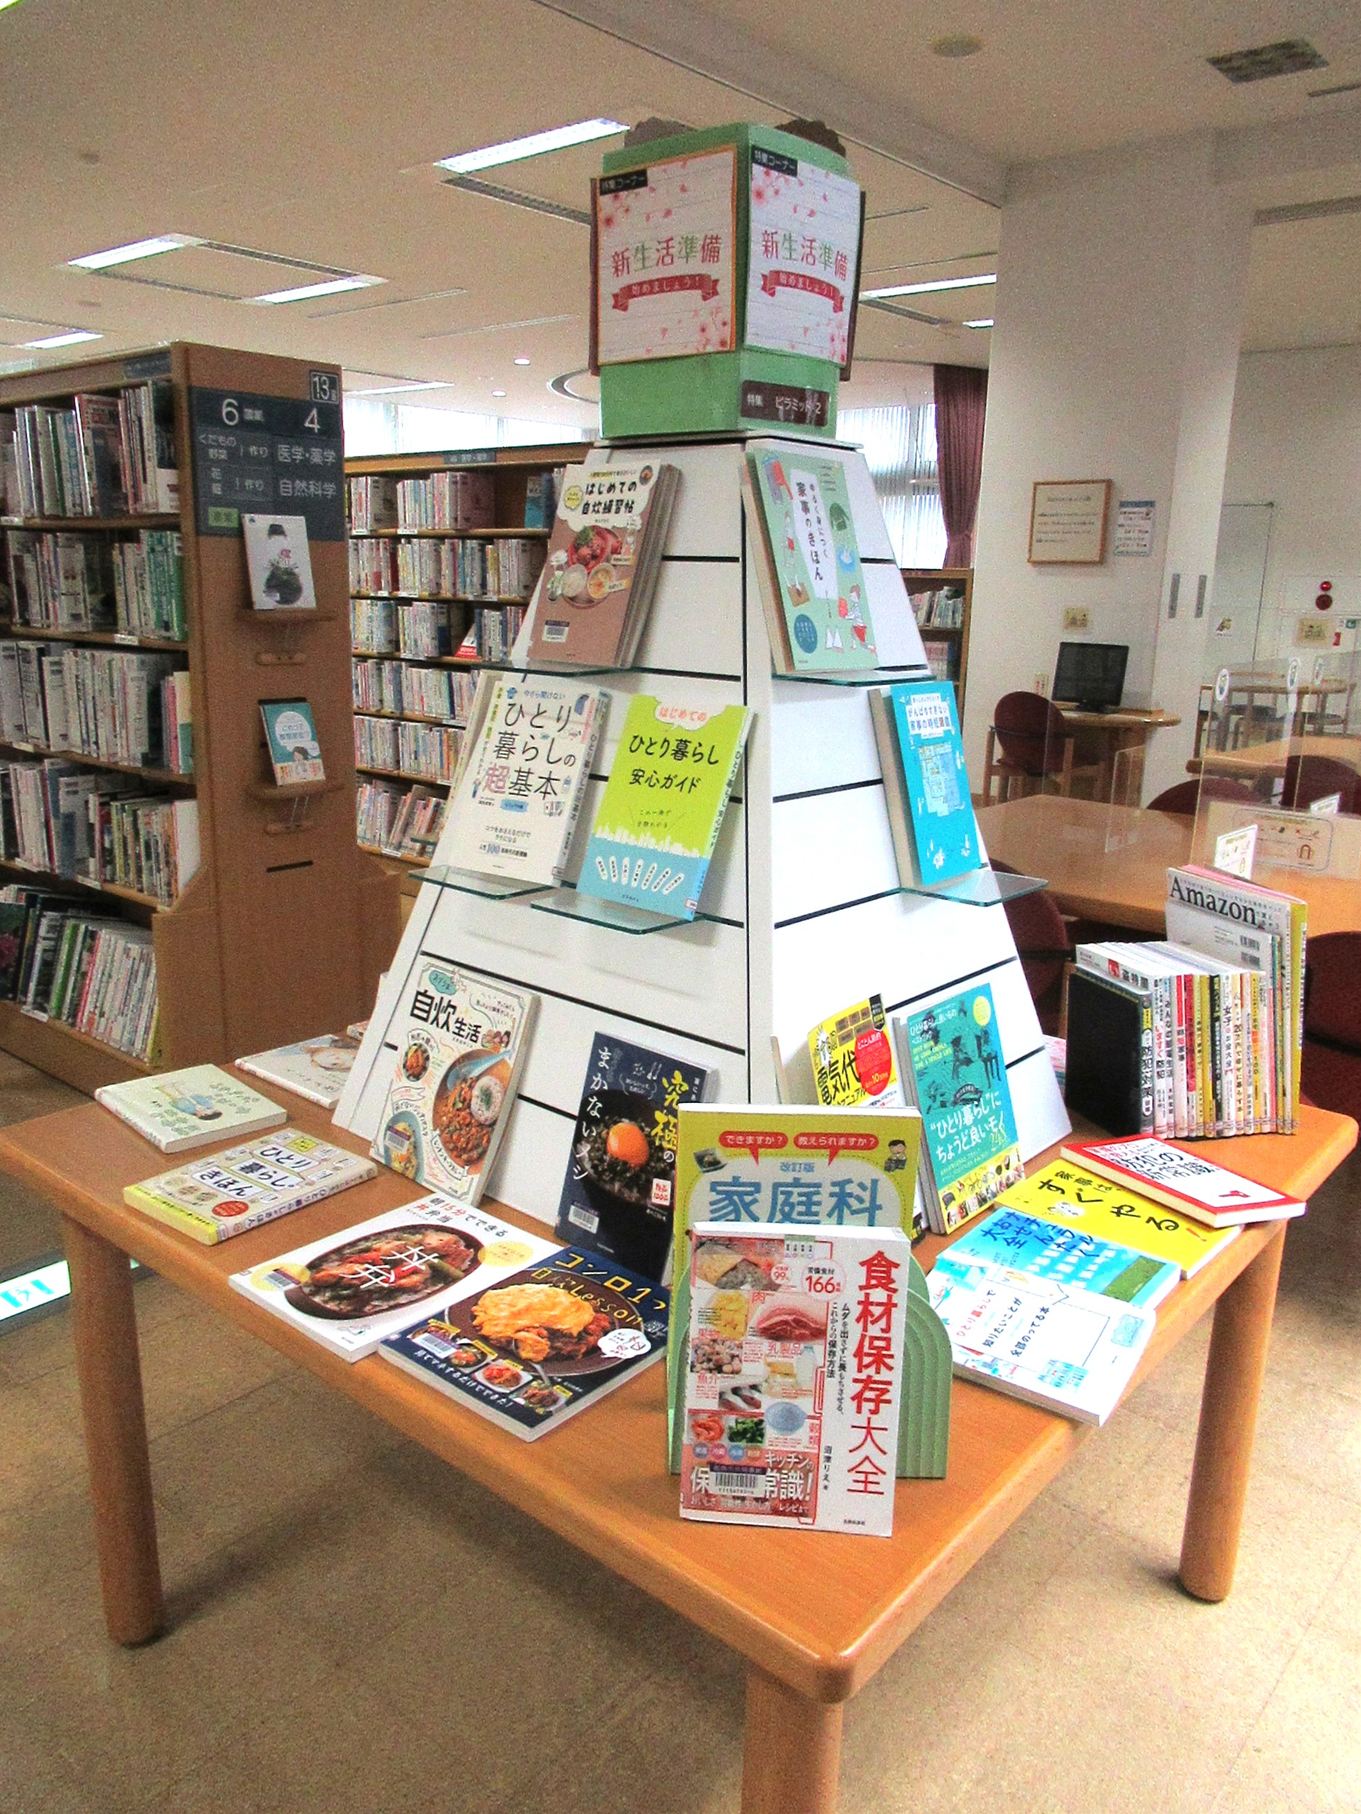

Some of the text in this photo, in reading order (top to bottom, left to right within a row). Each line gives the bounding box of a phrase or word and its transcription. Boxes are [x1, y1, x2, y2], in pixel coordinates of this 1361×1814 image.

[754, 150, 797, 176] 特集コーナー
[611, 234, 722, 278] 新生活準備
[762, 229, 848, 281] 新生活準備
[312, 376, 330, 400] 13
[222, 399, 239, 426] 6
[304, 407, 321, 433] 4
[279, 480, 336, 499] 自然科学
[585, 481, 638, 496] はじめての
[581, 500, 635, 515] 自炊練習帖
[795, 481, 824, 582] 家事のきほん
[504, 702, 572, 733] ひとり
[658, 706, 709, 724] はじめての
[493, 731, 576, 768] 暮らしの
[629, 734, 720, 766] ひとり暮らし
[483, 762, 561, 800] 超基本
[629, 768, 701, 795] 安心ガイド
[1169, 876, 1257, 926] Amazon
[411, 989, 483, 1044] 自炊生活
[572, 1046, 612, 1181] まかないメシ
[726, 1134, 783, 1146] できますか?
[797, 1135, 877, 1148] 教えられますか?
[260, 1147, 312, 1169] ひとり
[779, 1161, 816, 1173] 改訂版
[200, 1168, 252, 1198] きほん
[708, 1175, 884, 1227] 家庭科
[980, 1228, 1028, 1250] 大全
[805, 1275, 836, 1294] 166
[846, 1250, 901, 1496] 食材保存大全
